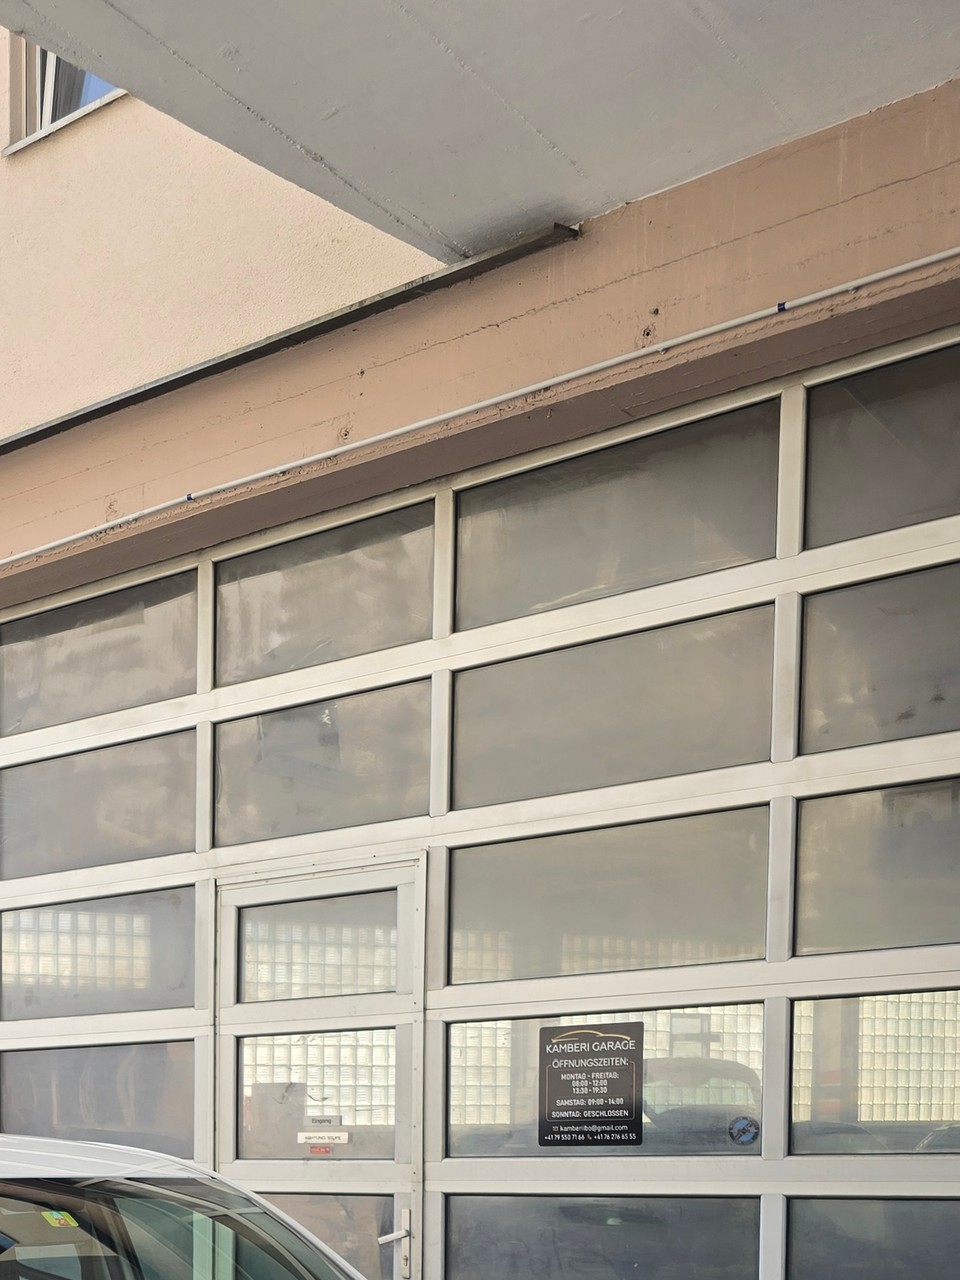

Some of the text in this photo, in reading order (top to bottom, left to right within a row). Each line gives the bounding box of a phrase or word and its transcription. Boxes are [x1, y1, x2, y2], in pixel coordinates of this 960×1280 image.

[546, 1040, 636, 1053] KAMBERI GARAGE
[552, 1057, 628, 1068] ÖFFNUNGSZEITEN:
[561, 1072, 586, 1080] MONTAG
[591, 1071, 619, 1079] FREITAG:
[583, 1109, 629, 1117] GESCHLOSSEN
